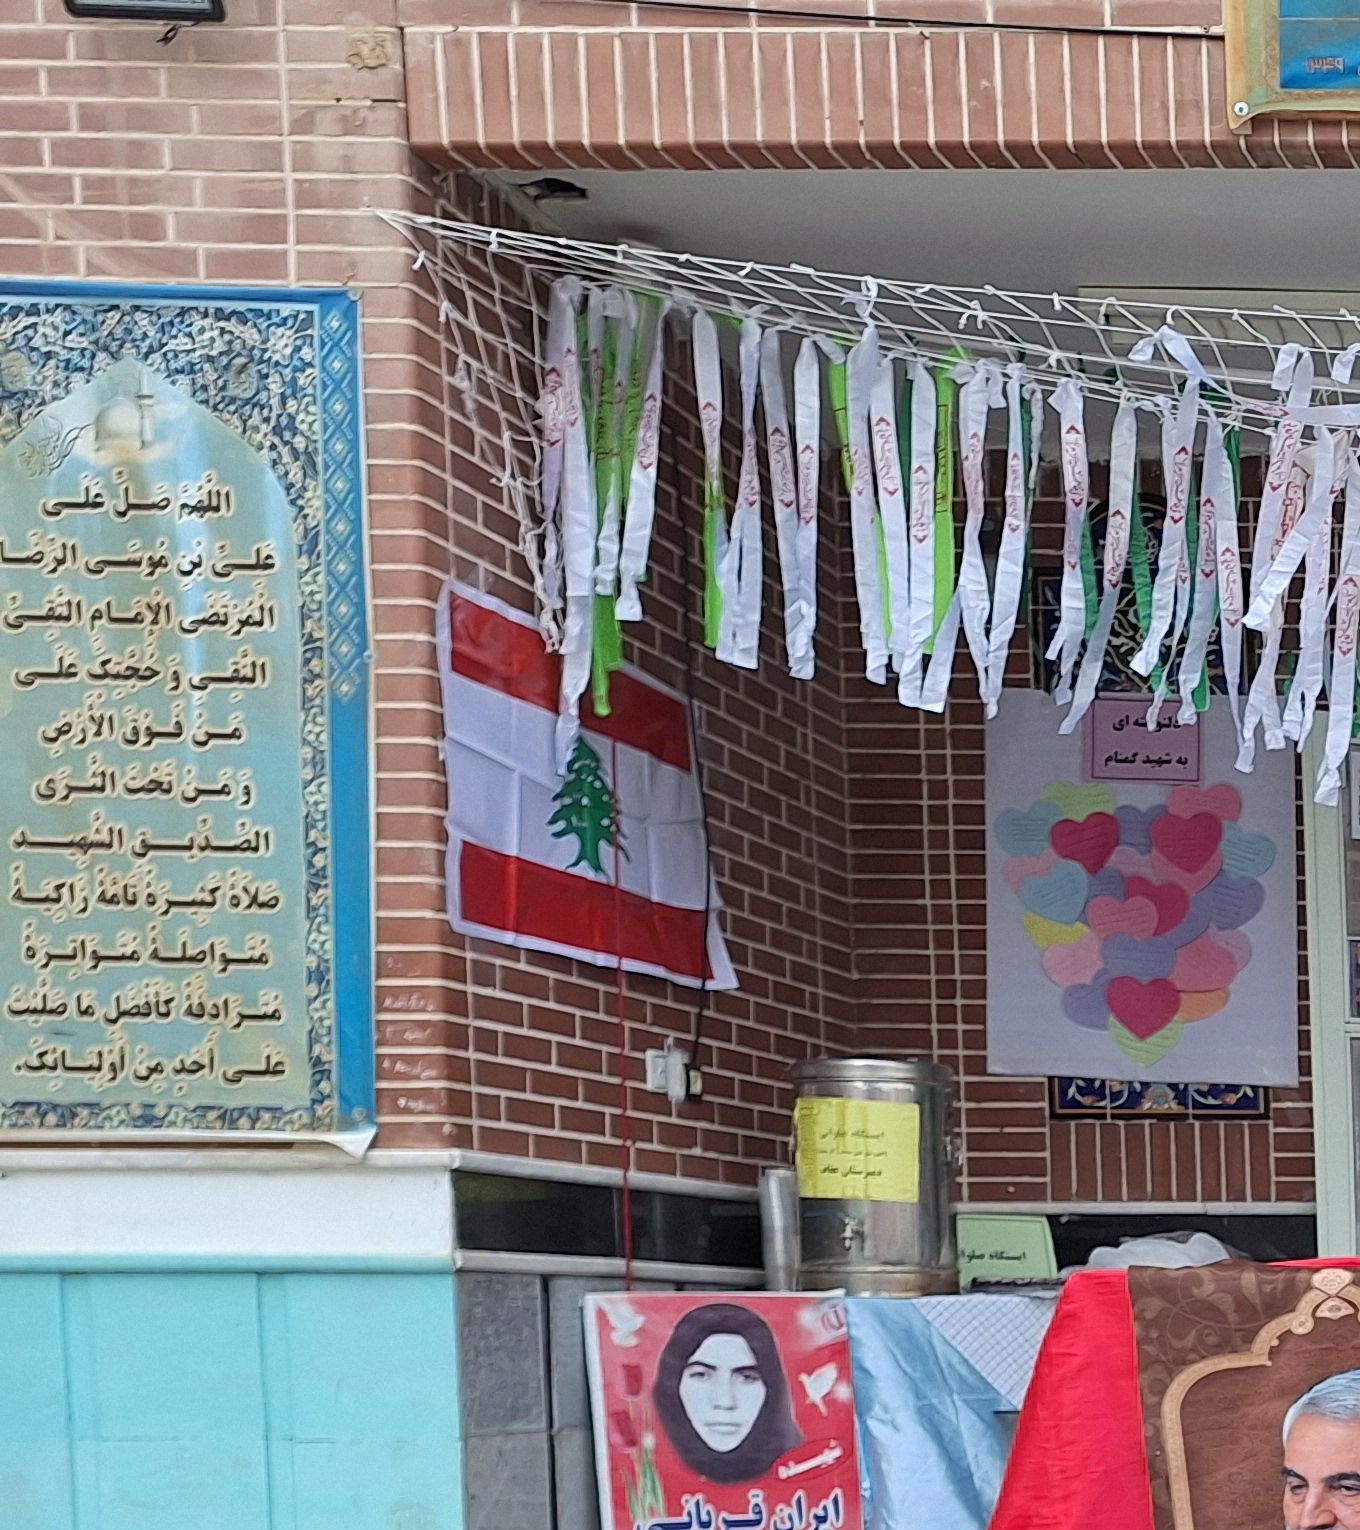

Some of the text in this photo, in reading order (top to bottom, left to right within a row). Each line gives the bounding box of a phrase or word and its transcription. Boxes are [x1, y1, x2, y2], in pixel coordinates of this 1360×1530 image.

[1113, 715, 1129, 731] ای
[1104, 751, 1188, 769] به شهید گمنام
[989, 1250, 1026, 1261] ایستگاه
